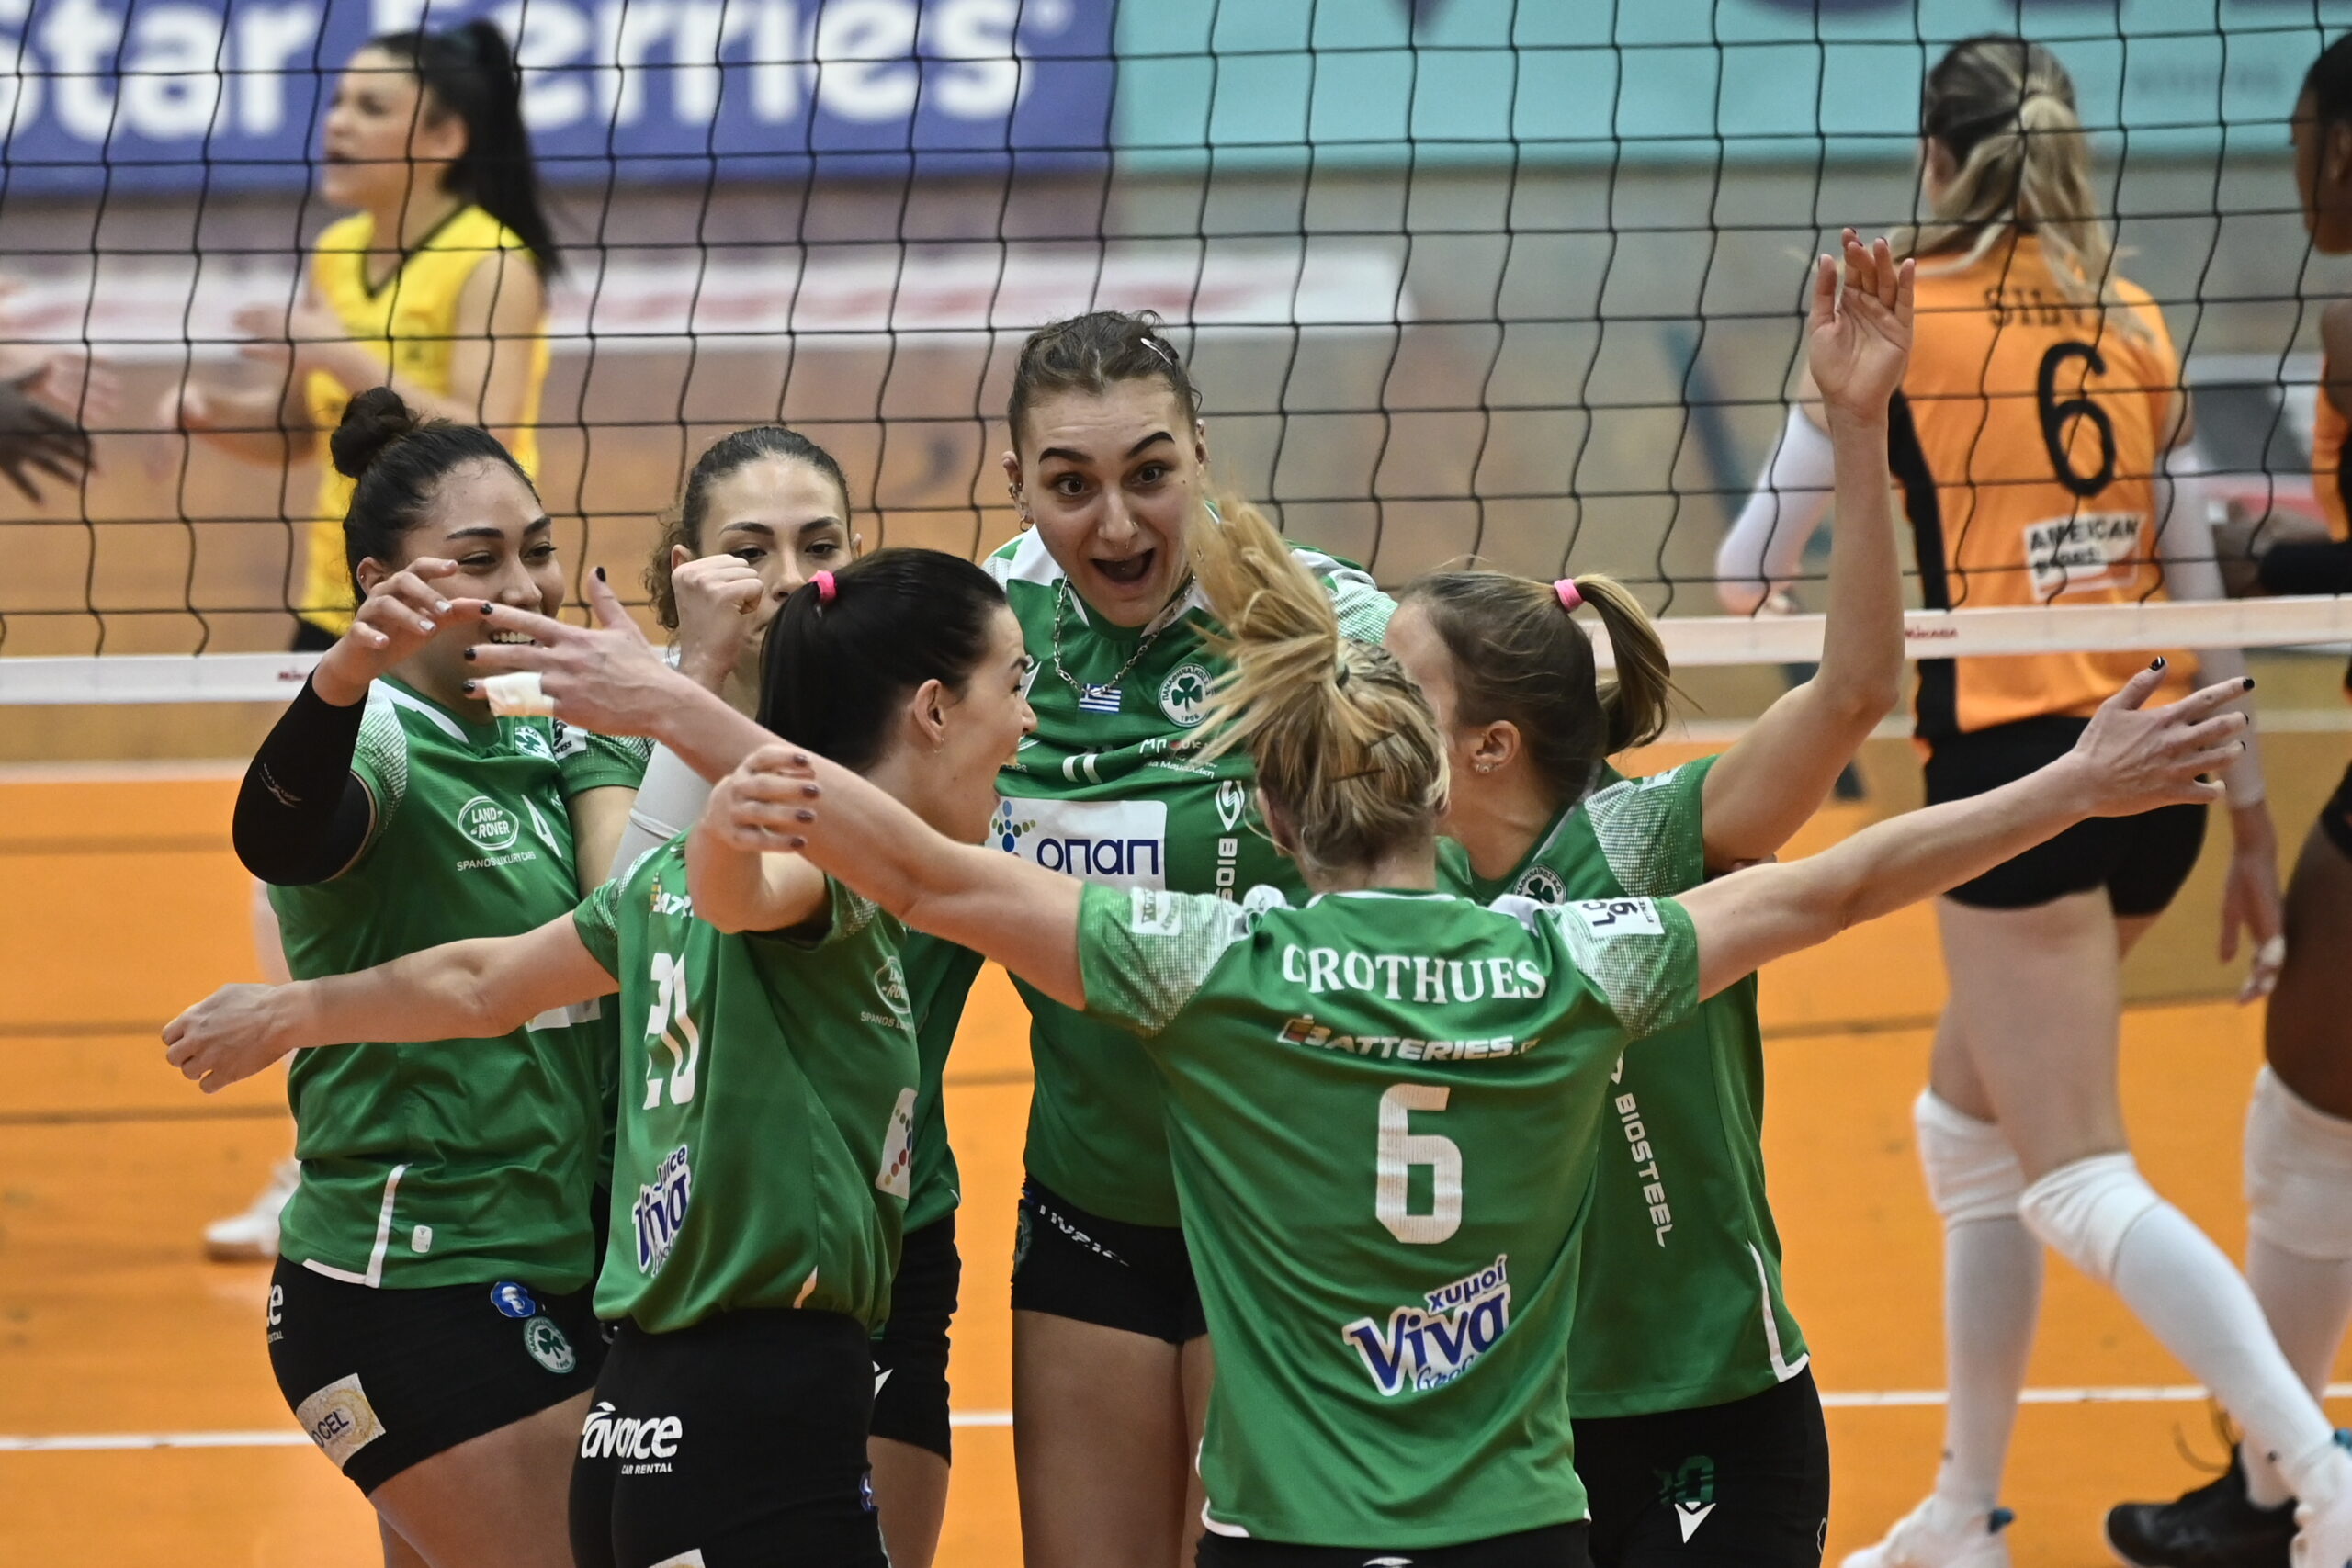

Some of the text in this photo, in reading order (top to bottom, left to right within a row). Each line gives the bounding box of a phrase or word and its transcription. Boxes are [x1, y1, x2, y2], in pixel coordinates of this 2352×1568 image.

[2037, 340, 2115, 498] 6
[471, 807, 497, 824] LAND
[478, 820, 511, 839] ROVER
[456, 856, 496, 872] SPANOS
[1375, 1083, 1463, 1245] 6
[1614, 1092, 1674, 1248] BIOSTEEL
[1349, 1292, 1506, 1390] Viva
[634, 1461, 673, 1475] RENTAL
